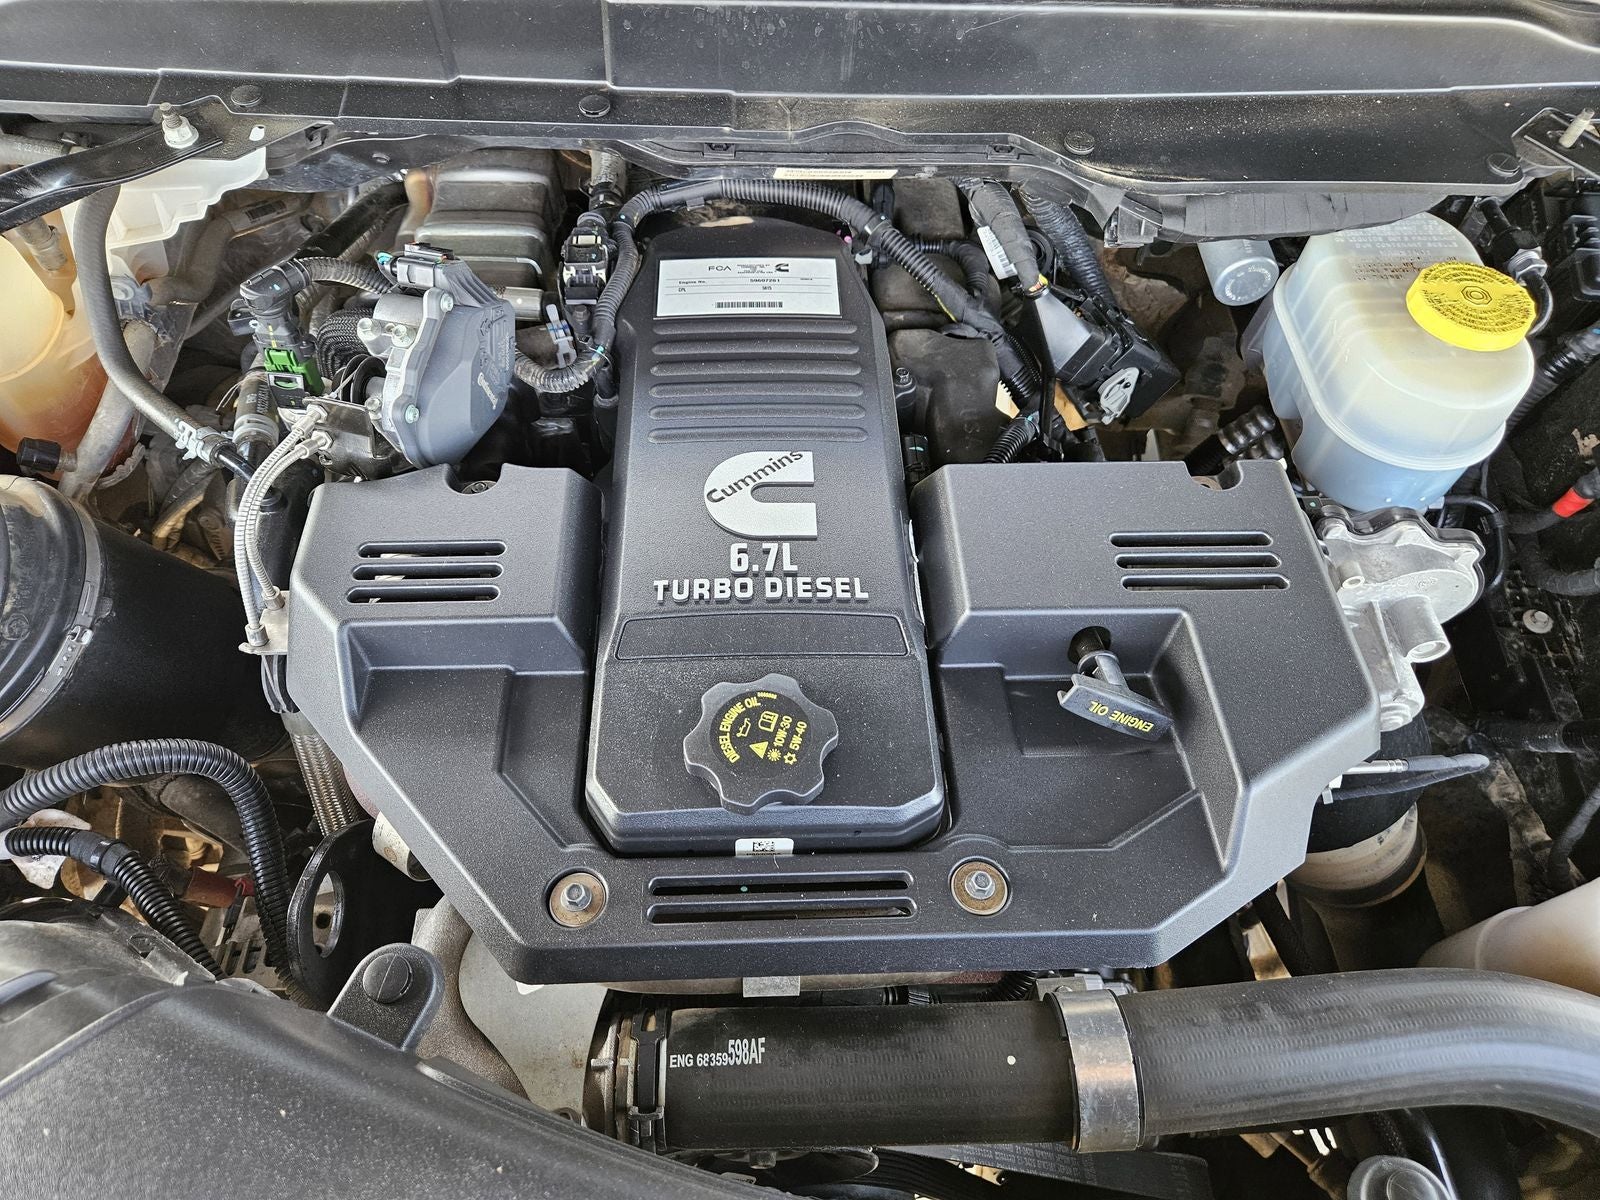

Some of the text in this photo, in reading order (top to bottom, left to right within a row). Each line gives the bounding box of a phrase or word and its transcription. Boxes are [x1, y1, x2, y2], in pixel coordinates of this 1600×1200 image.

[706, 450, 804, 503] Cummins
[730, 542, 799, 575] 6.7L
[653, 576, 869, 603] TURBO DIESEL
[718, 696, 761, 764] DIESEL ENGINE OIL
[773, 715, 793, 748] 10W-30
[1088, 700, 1154, 732] ENGINE OIL
[789, 721, 808, 751] 5W-40
[669, 1053, 694, 1068] ENG
